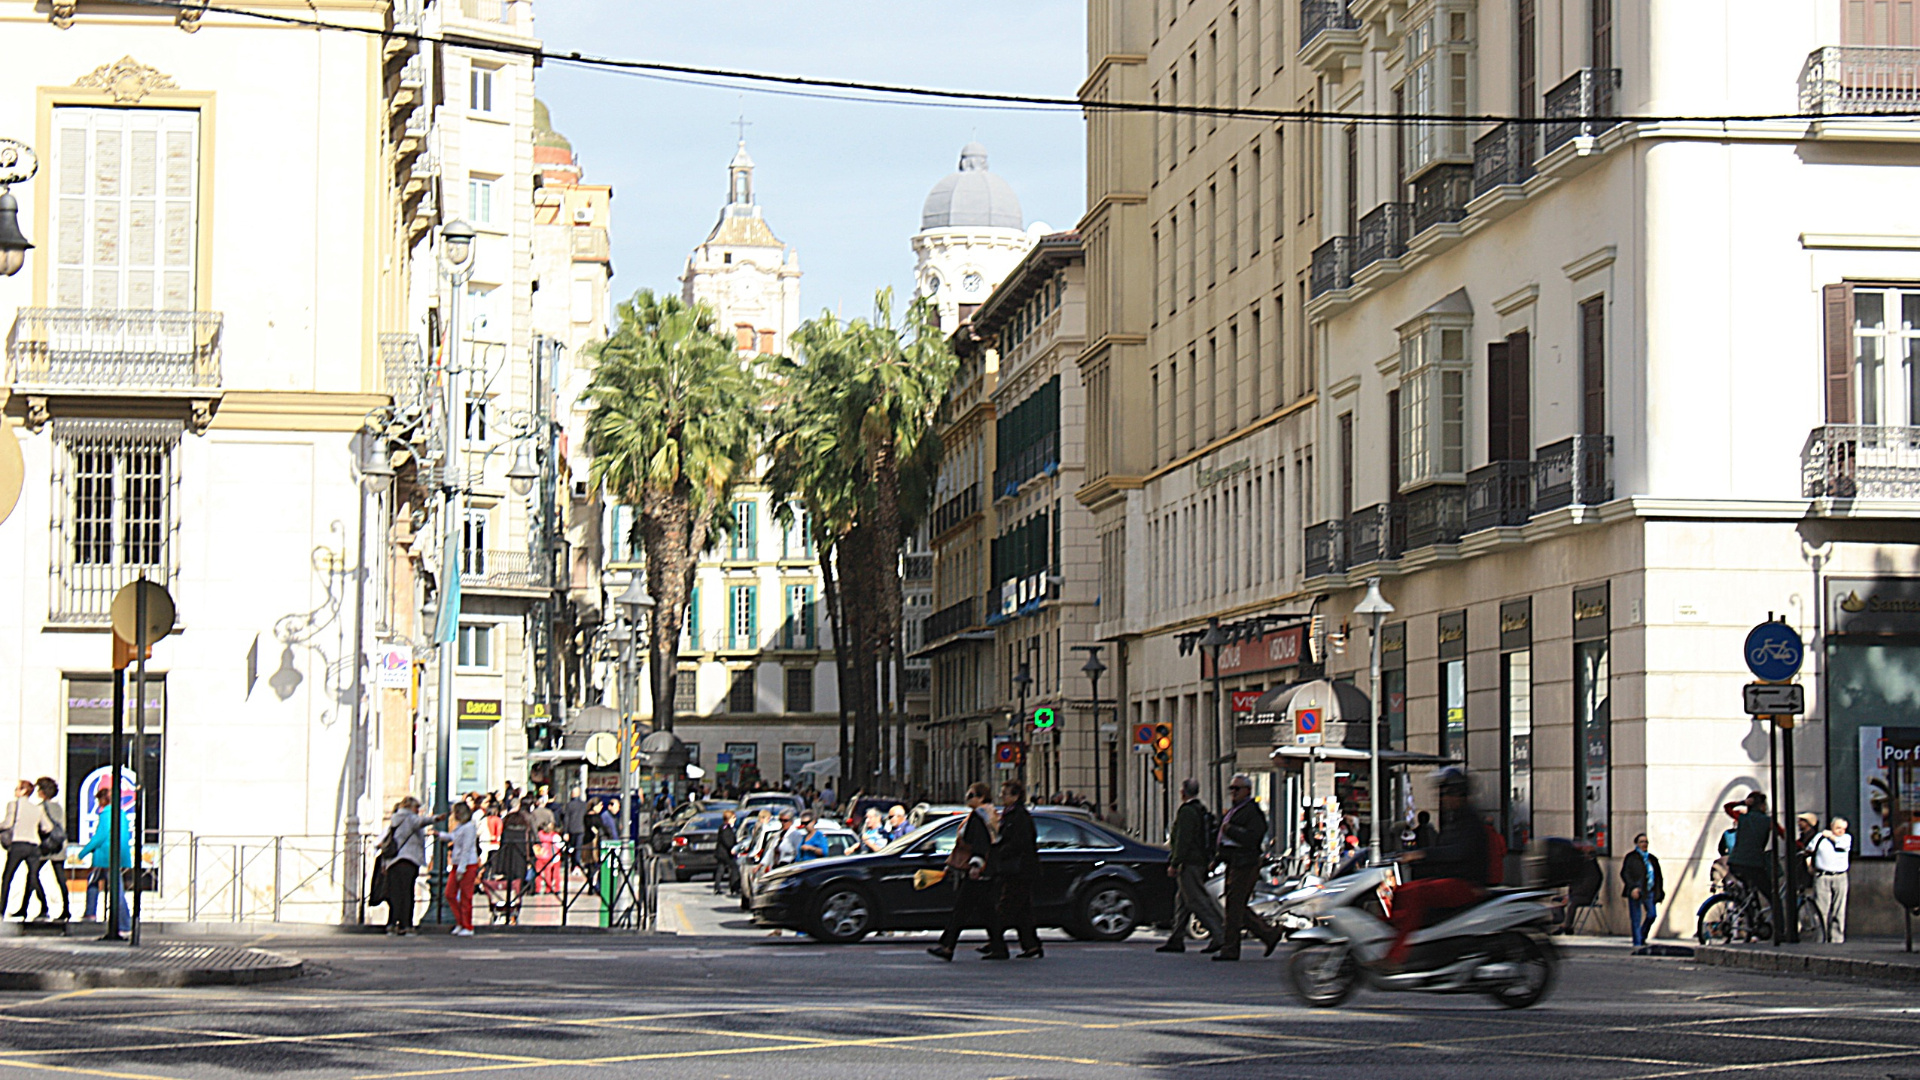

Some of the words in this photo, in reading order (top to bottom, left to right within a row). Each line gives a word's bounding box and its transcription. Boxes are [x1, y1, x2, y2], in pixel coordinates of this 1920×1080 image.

[1868, 594, 1920, 613] Santa
[466, 701, 497, 714] Bankia
[1884, 745, 1912, 760] Por
